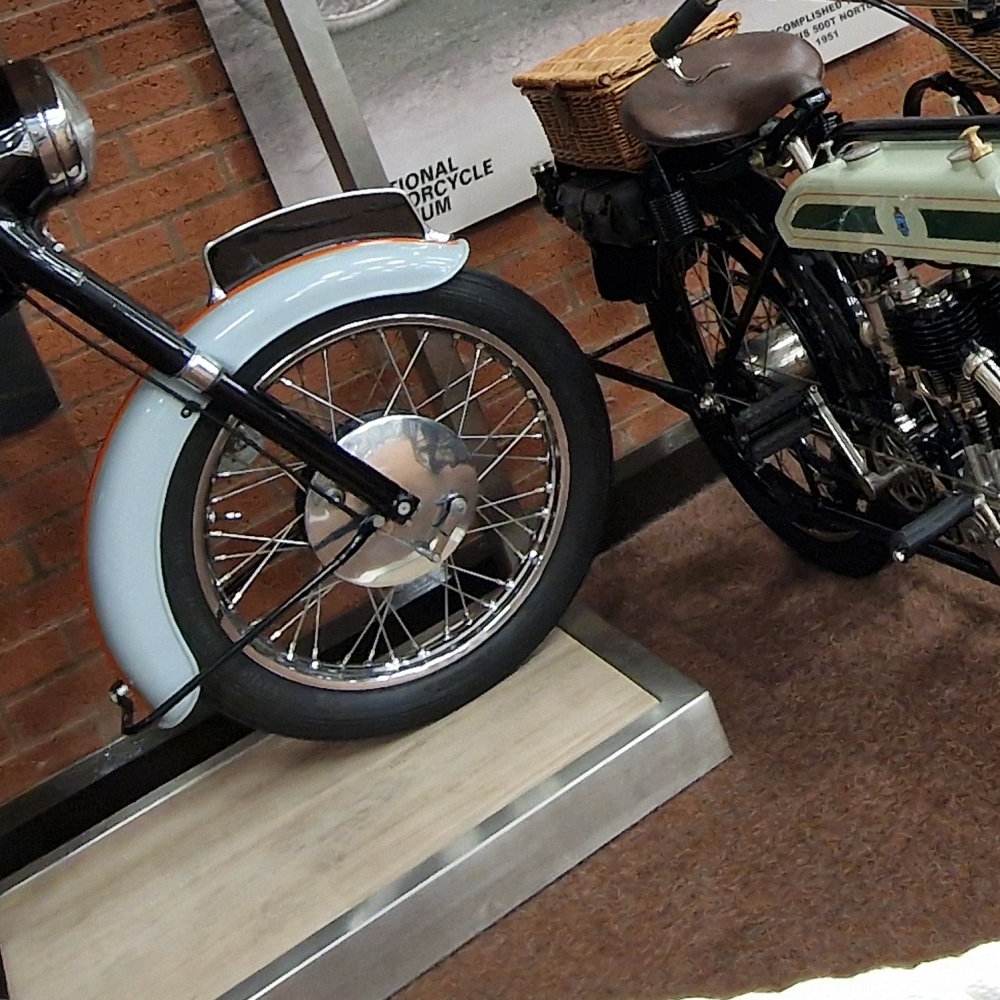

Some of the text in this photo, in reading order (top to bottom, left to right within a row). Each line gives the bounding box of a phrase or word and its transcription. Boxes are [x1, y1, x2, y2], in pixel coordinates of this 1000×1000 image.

[812, 16, 836, 33] 500T
[839, 3, 873, 22] NORTO
[815, 29, 839, 45] 1951
[390, 156, 459, 190] IONAL
[408, 158, 494, 207] ORCYCLE
